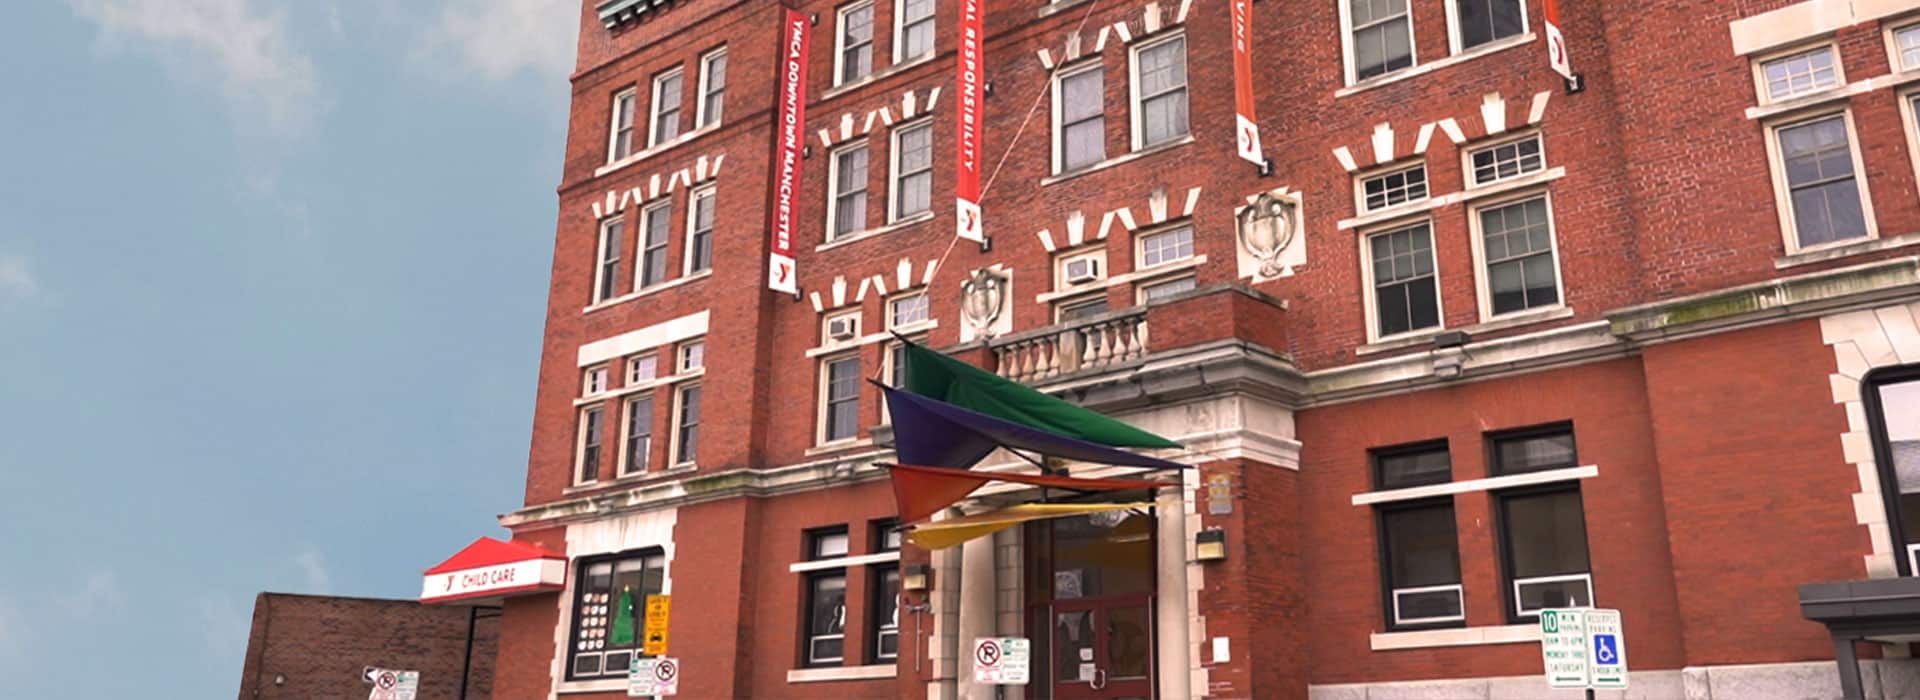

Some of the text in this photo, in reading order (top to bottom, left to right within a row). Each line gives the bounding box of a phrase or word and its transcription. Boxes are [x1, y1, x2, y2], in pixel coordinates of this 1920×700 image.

[963, 0, 977, 172] AL RESPONSIBILITY
[778, 21, 804, 250] YMCA DOWNTOWN MANCHESTER
[462, 571, 489, 588] CHILD
[491, 567, 515, 584] CARE
[1543, 612, 1557, 631] 10
